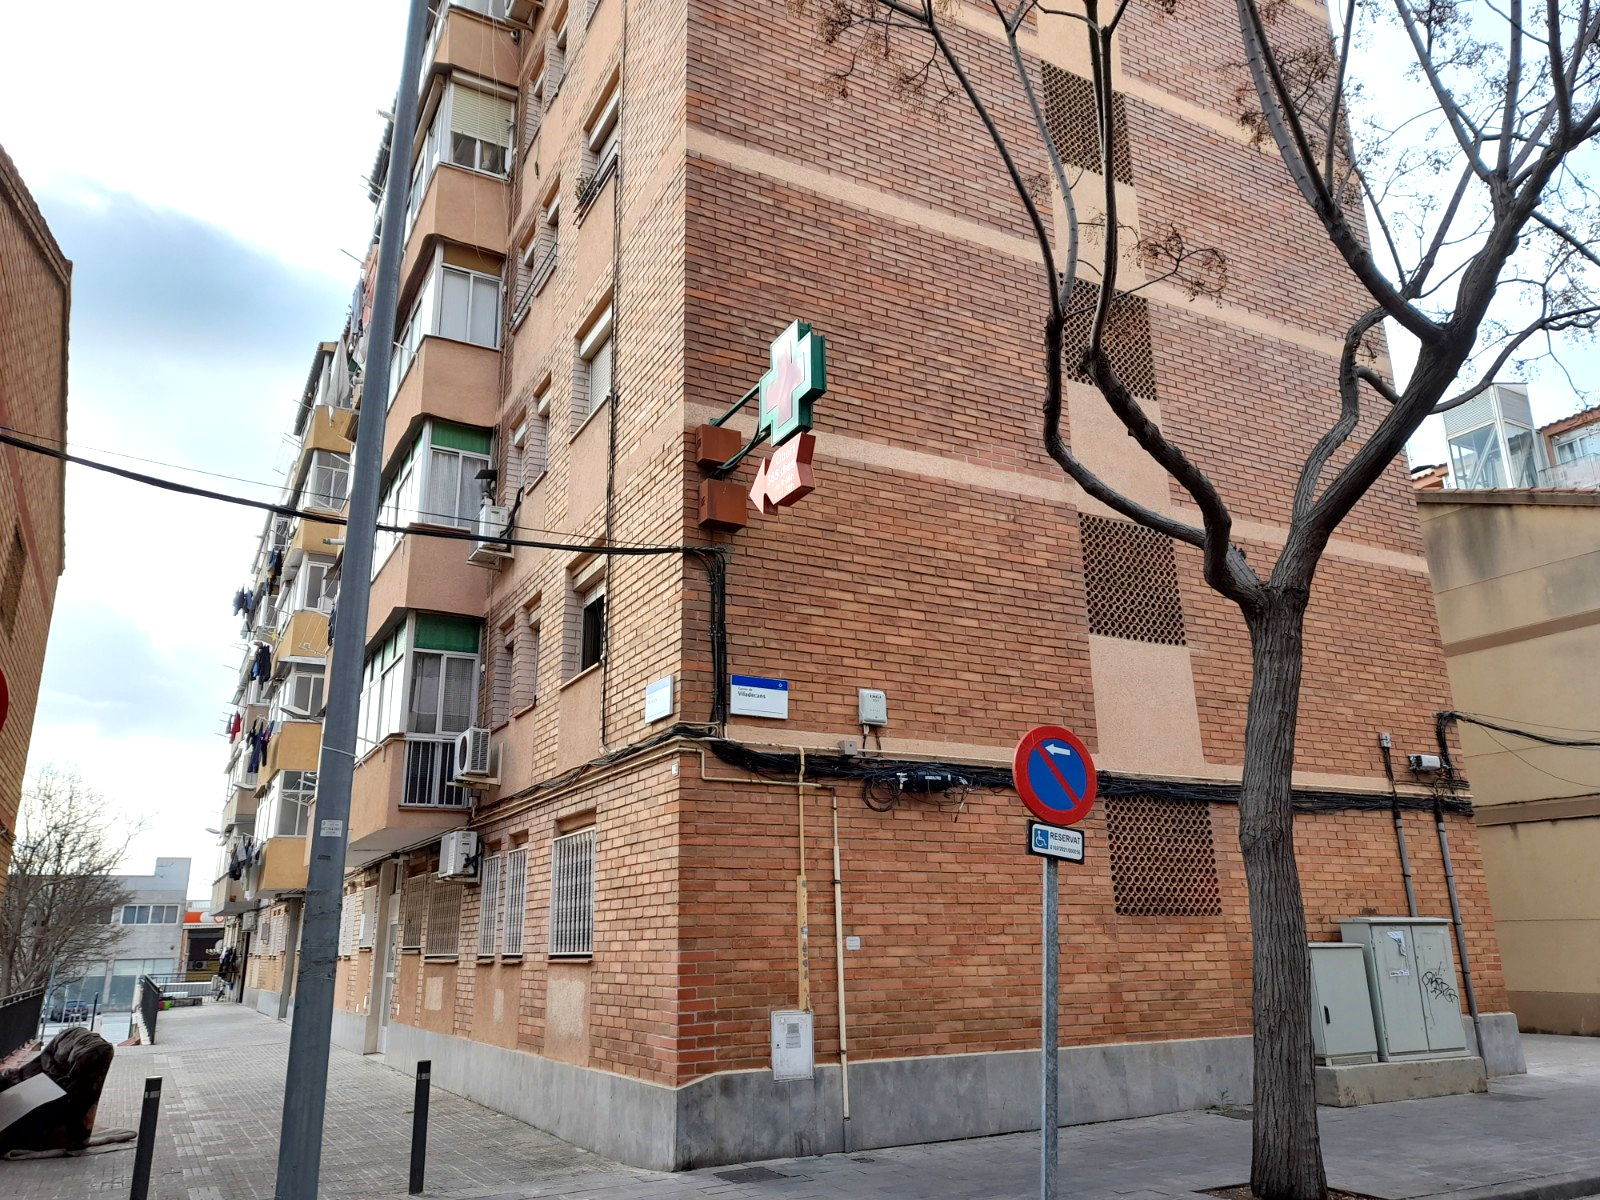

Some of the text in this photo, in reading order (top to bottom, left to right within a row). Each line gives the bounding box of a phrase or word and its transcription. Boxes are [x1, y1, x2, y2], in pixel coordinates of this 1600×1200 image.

[776, 443, 796, 466] Obert
[738, 691, 766, 699] Viladecans
[1050, 832, 1081, 845] RESERVAT
